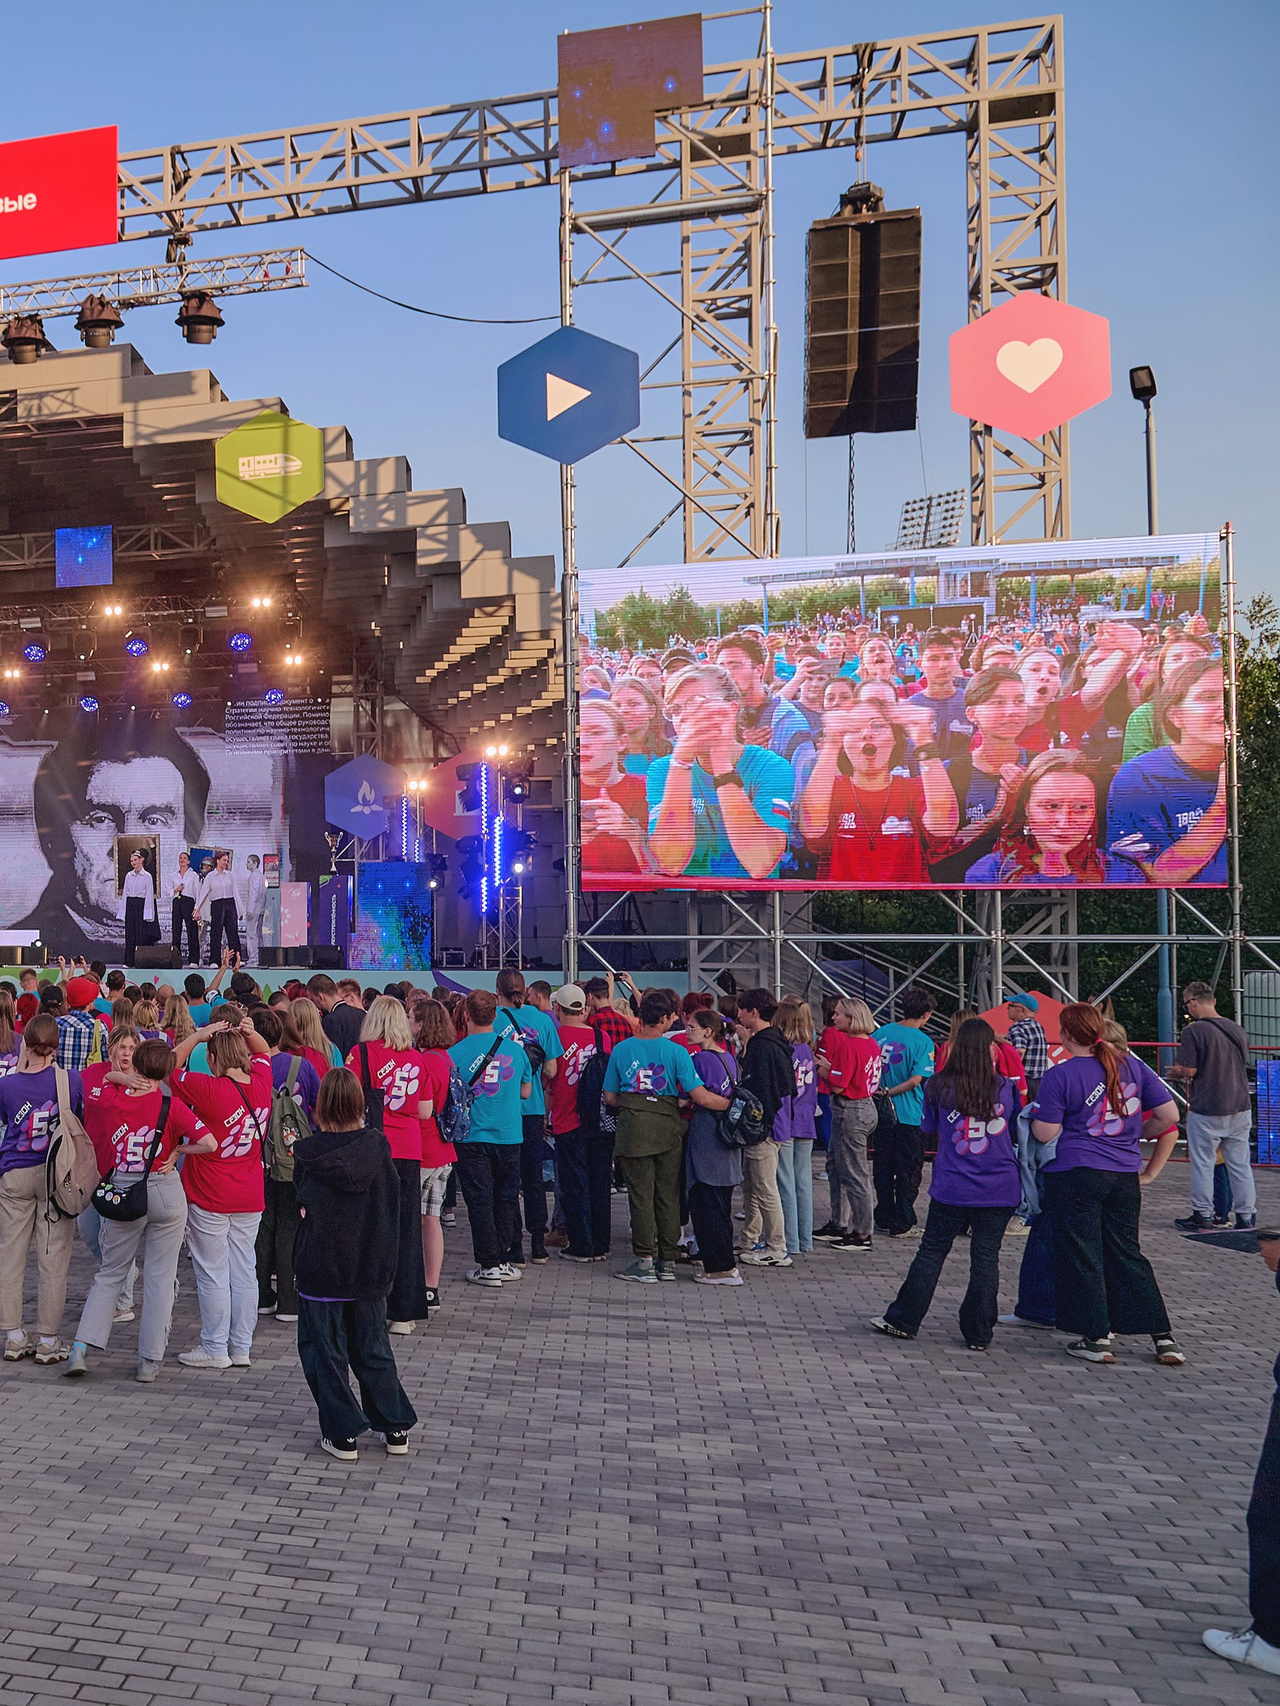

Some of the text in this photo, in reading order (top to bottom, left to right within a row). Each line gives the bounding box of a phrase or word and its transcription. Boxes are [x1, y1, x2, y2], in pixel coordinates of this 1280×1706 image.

[225, 713, 262, 721] Российской
[275, 719, 298, 727] общее
[299, 740, 318, 748] науке
[563, 1042, 579, 1060] СЕЗОН
[880, 1044, 894, 1064] 5
[377, 1059, 396, 1079] СЕЗОН
[469, 1052, 486, 1073] СЕЗОН
[485, 1061, 500, 1083] 5
[391, 1071, 409, 1097] 5
[638, 1069, 653, 1090] 5
[796, 1066, 806, 1087] 5
[1085, 1082, 1106, 1107] СЕЗОН
[14, 1101, 32, 1125] СЕЗОН
[224, 1105, 246, 1128] СЕЗОН
[946, 1109, 961, 1124] СЕЗ
[31, 1111, 50, 1138] 5
[111, 1122, 129, 1146] СЕЗОН
[238, 1117, 256, 1144] 5
[126, 1136, 145, 1162] 5
